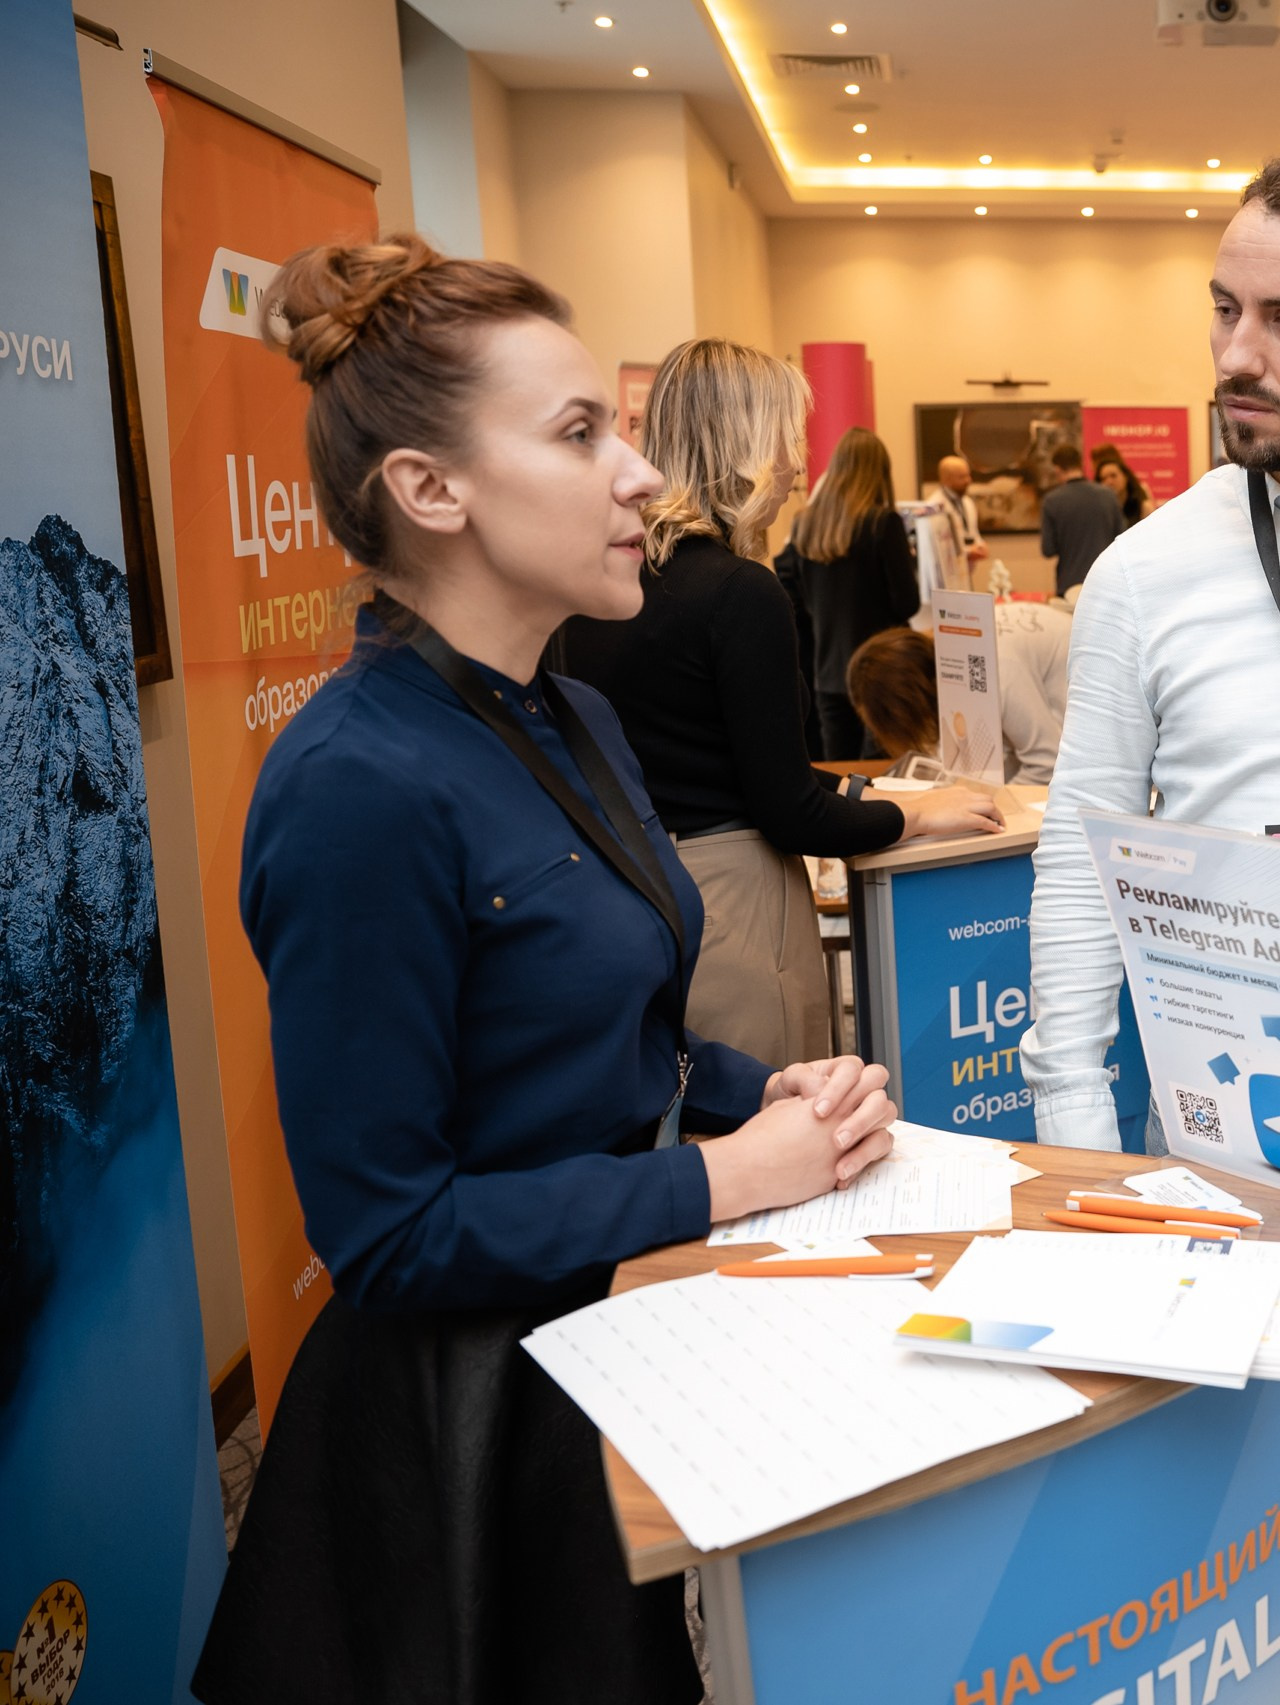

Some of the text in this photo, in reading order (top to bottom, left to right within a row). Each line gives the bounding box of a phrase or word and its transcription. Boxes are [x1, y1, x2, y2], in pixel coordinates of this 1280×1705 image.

[226, 454, 352, 578] Цен
[239, 584, 362, 654] интерне
[245, 667, 338, 733] образо
[948, 914, 1031, 941] webcom-
[1129, 917, 1142, 934] в
[1144, 915, 1247, 951] Telegram
[1146, 952, 1206, 974] Минимальный
[1206, 966, 1241, 981] бюджет
[1250, 976, 1279, 990] месяц
[1159, 979, 1195, 996] большие
[1163, 997, 1235, 1021] гибкие таргетинги
[1167, 1015, 1246, 1040] низкая конкуренция
[31, 1629, 70, 1685] ВЫБОР
[42, 1655, 64, 1685] ГОДА
